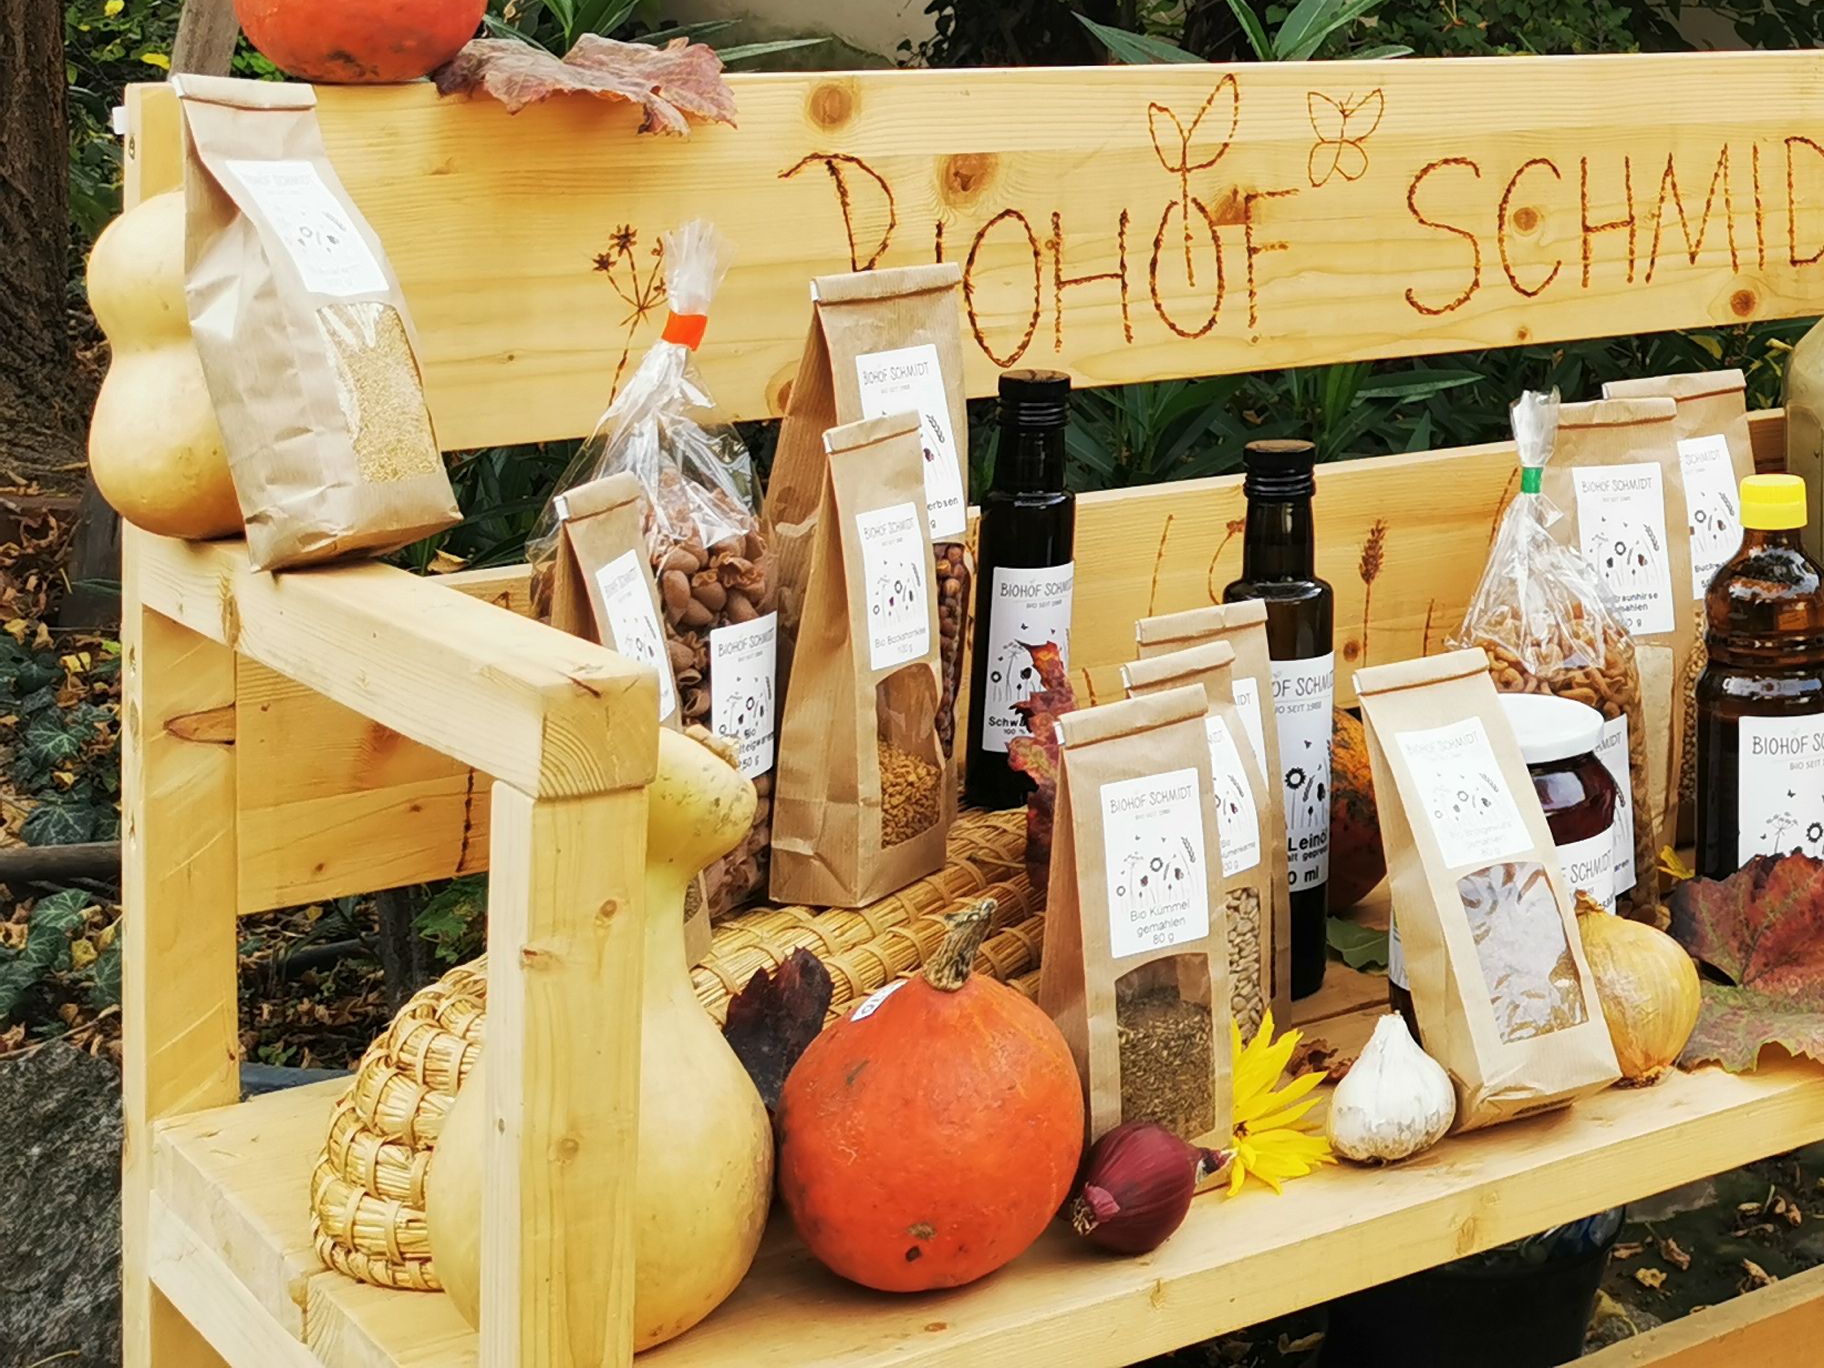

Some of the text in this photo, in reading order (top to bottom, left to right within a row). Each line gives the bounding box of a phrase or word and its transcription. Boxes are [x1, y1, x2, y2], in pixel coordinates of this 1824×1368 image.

[926, 497, 959, 511] erbsen
[1000, 582, 1042, 597] BIOHOF
[1752, 735, 1809, 755] BIOHOF
[1110, 785, 1193, 814] BIOHOF SCHMIDT
[1305, 865, 1319, 882] ml
[1130, 898, 1191, 923] Bio Kümmel
[1137, 915, 1186, 938] gemahlen
[1153, 932, 1175, 945] 80 g
